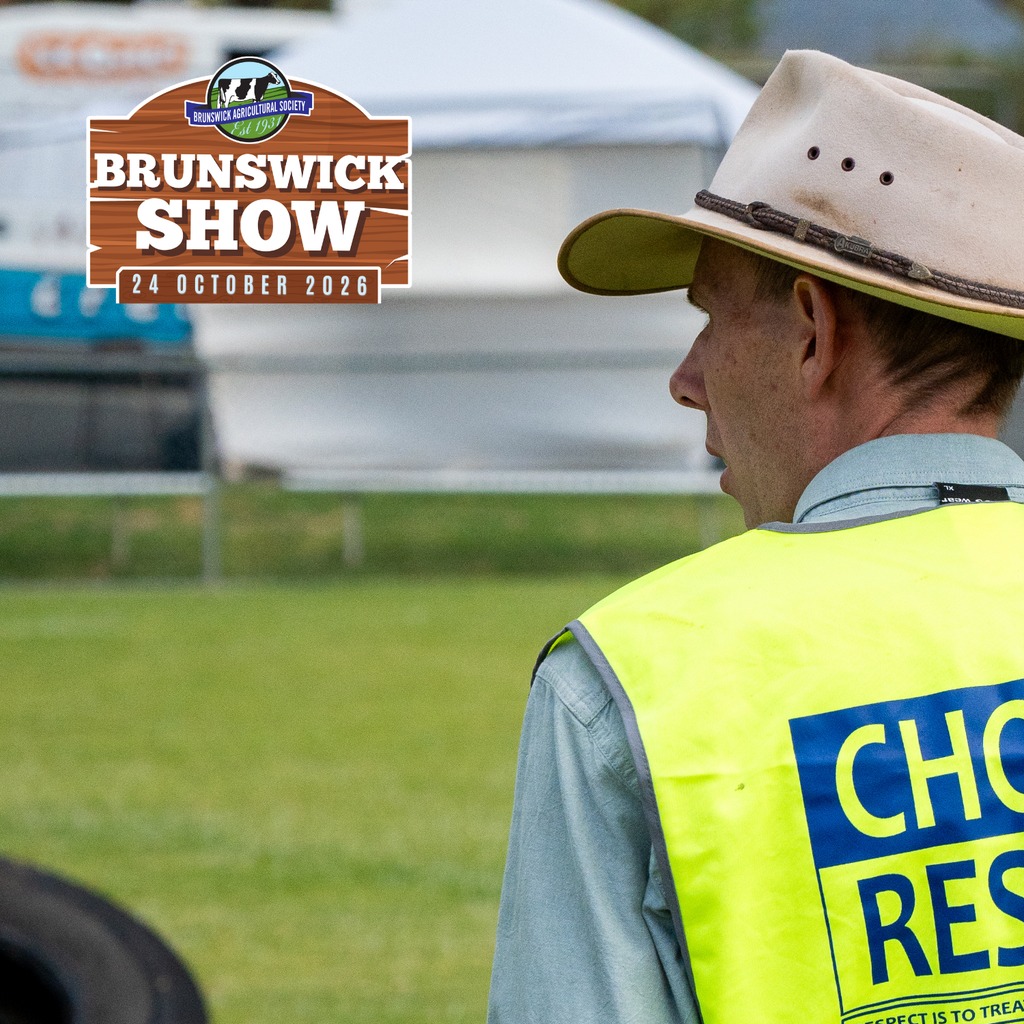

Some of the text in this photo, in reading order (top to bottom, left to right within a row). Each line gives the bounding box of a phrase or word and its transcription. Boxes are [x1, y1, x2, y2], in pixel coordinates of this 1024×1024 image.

[836, 237, 870, 254] AKUBRA
[932, 1011, 948, 1024] IS
[950, 1008, 976, 1023] TO
